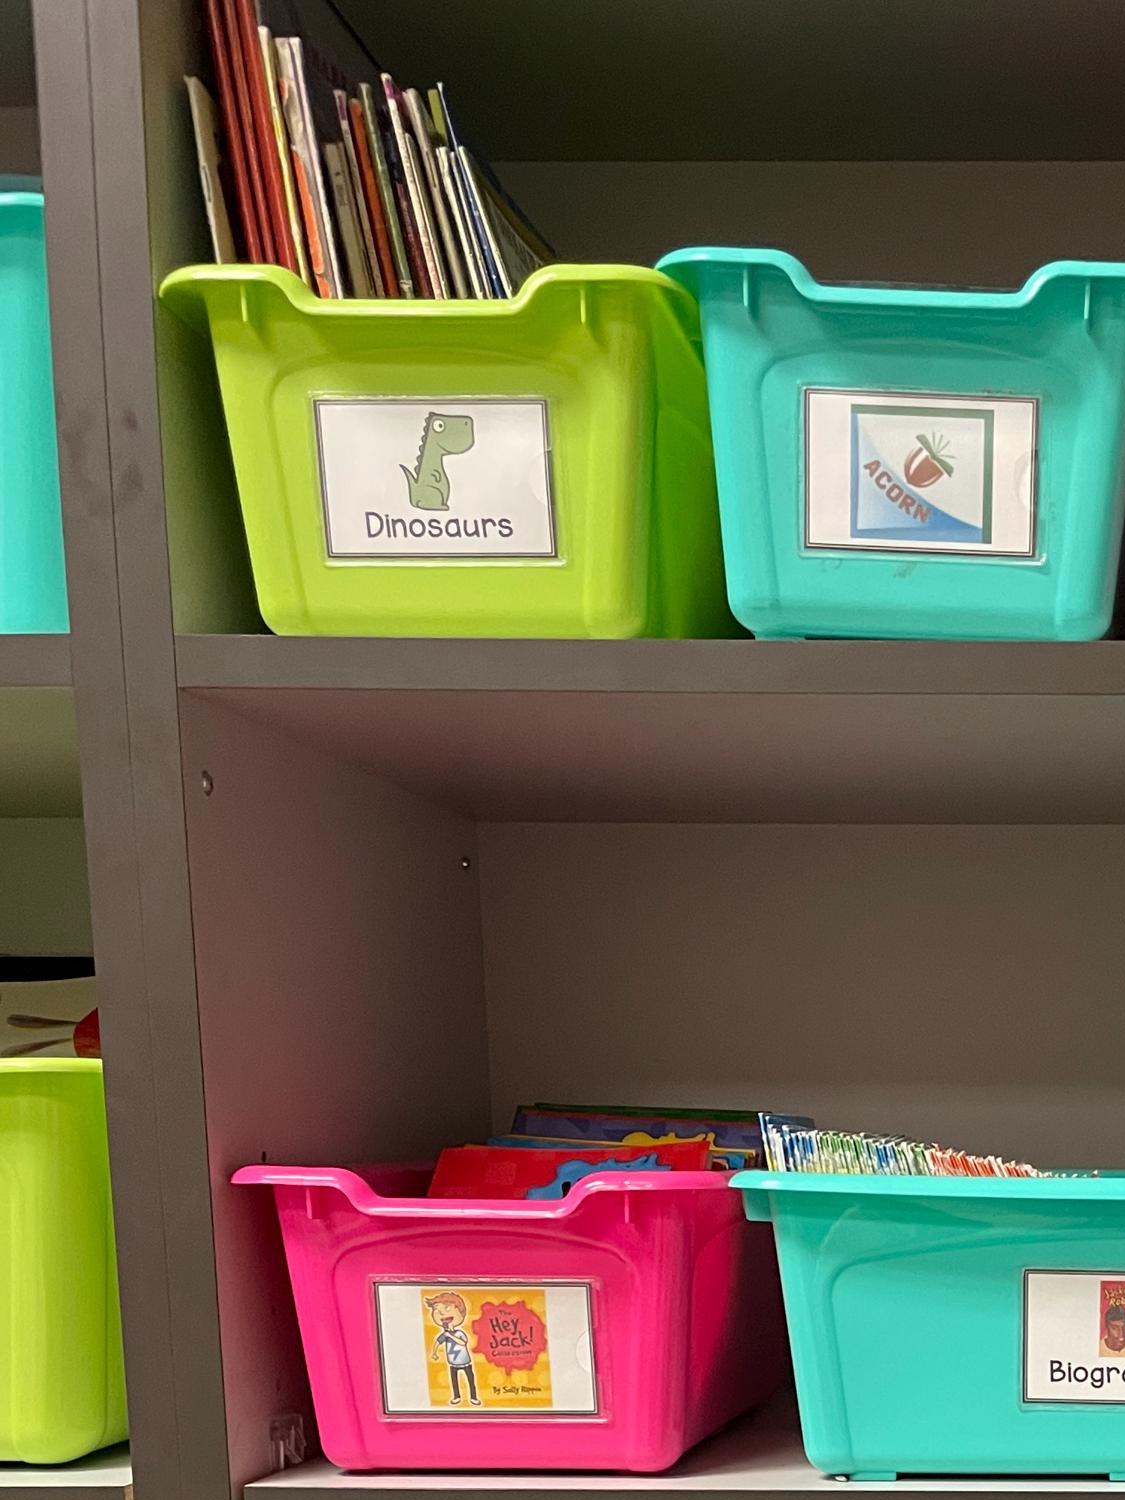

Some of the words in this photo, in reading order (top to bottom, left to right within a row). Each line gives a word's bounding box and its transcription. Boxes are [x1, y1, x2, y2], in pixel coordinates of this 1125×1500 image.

[863, 459, 933, 524] ACORN
[365, 511, 514, 539] Dinosaurs
[489, 1317, 519, 1335] Hey
[490, 1326, 534, 1349] Jack!
